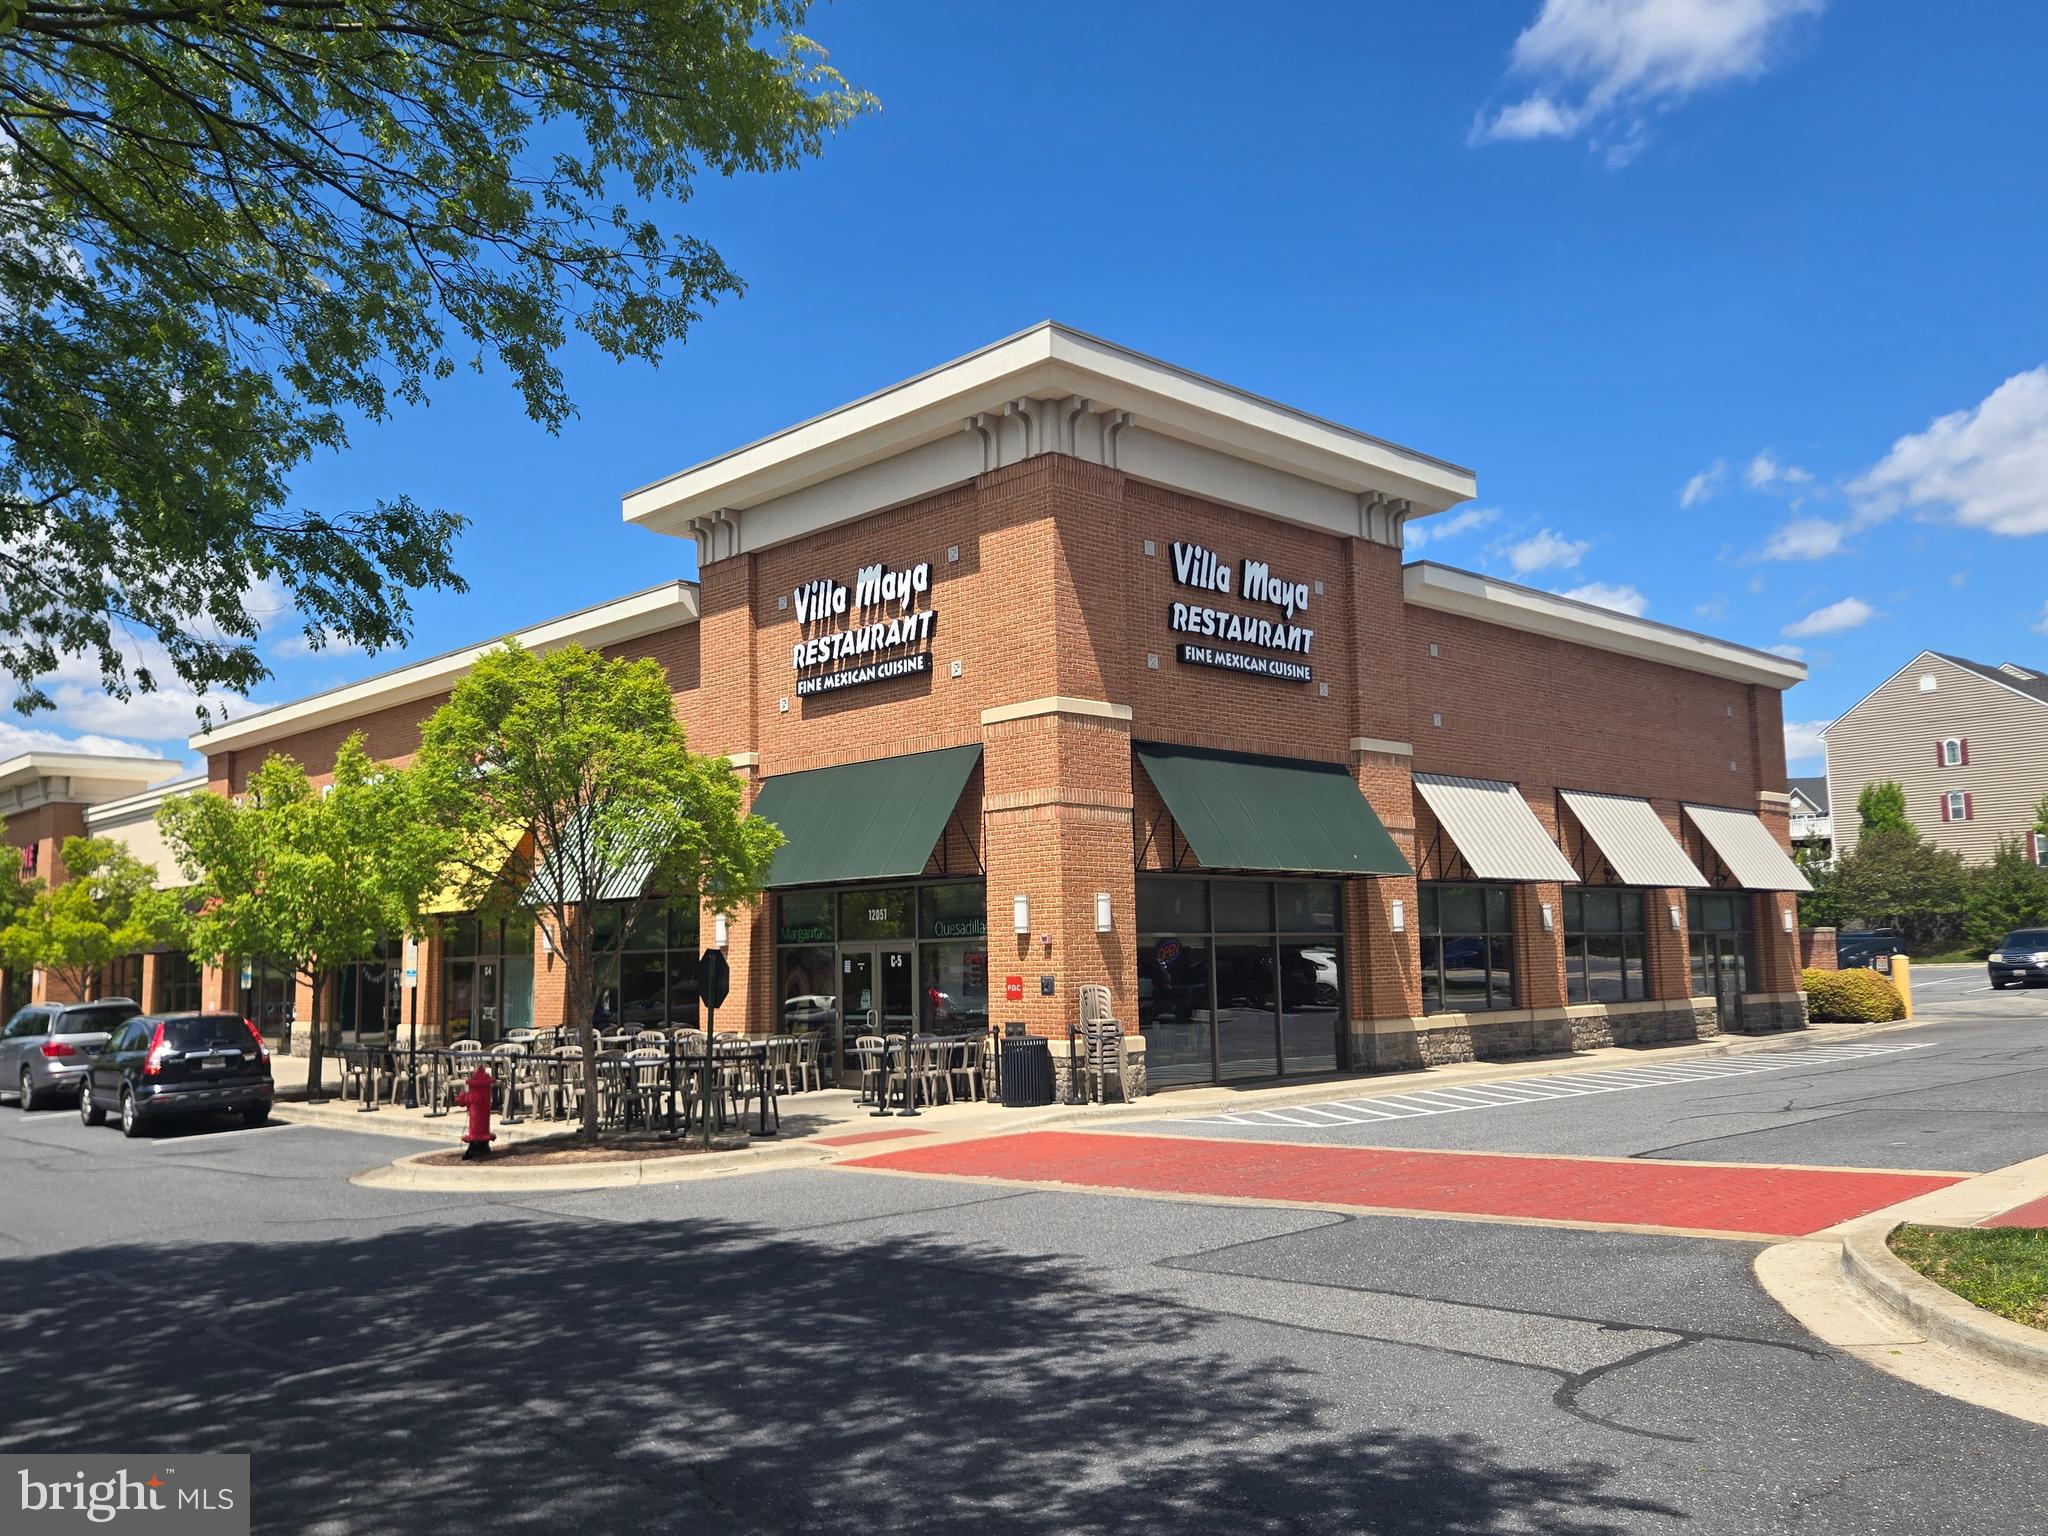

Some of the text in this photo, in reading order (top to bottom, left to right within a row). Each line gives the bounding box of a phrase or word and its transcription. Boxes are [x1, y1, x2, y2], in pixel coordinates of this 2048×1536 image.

[793, 562, 928, 624] Villa Maya
[1173, 541, 1309, 620] Villa Maya
[792, 609, 934, 670] RESTAURANT
[1172, 602, 1314, 654] RESTAURANT
[797, 655, 924, 695] FINE MEXICAN CUISINE
[1185, 645, 1311, 681] FINE MEXICAN CUISINE
[867, 908, 887, 921] 12051
[934, 918, 985, 937] Quesadilla
[890, 954, 902, 967] C-5
